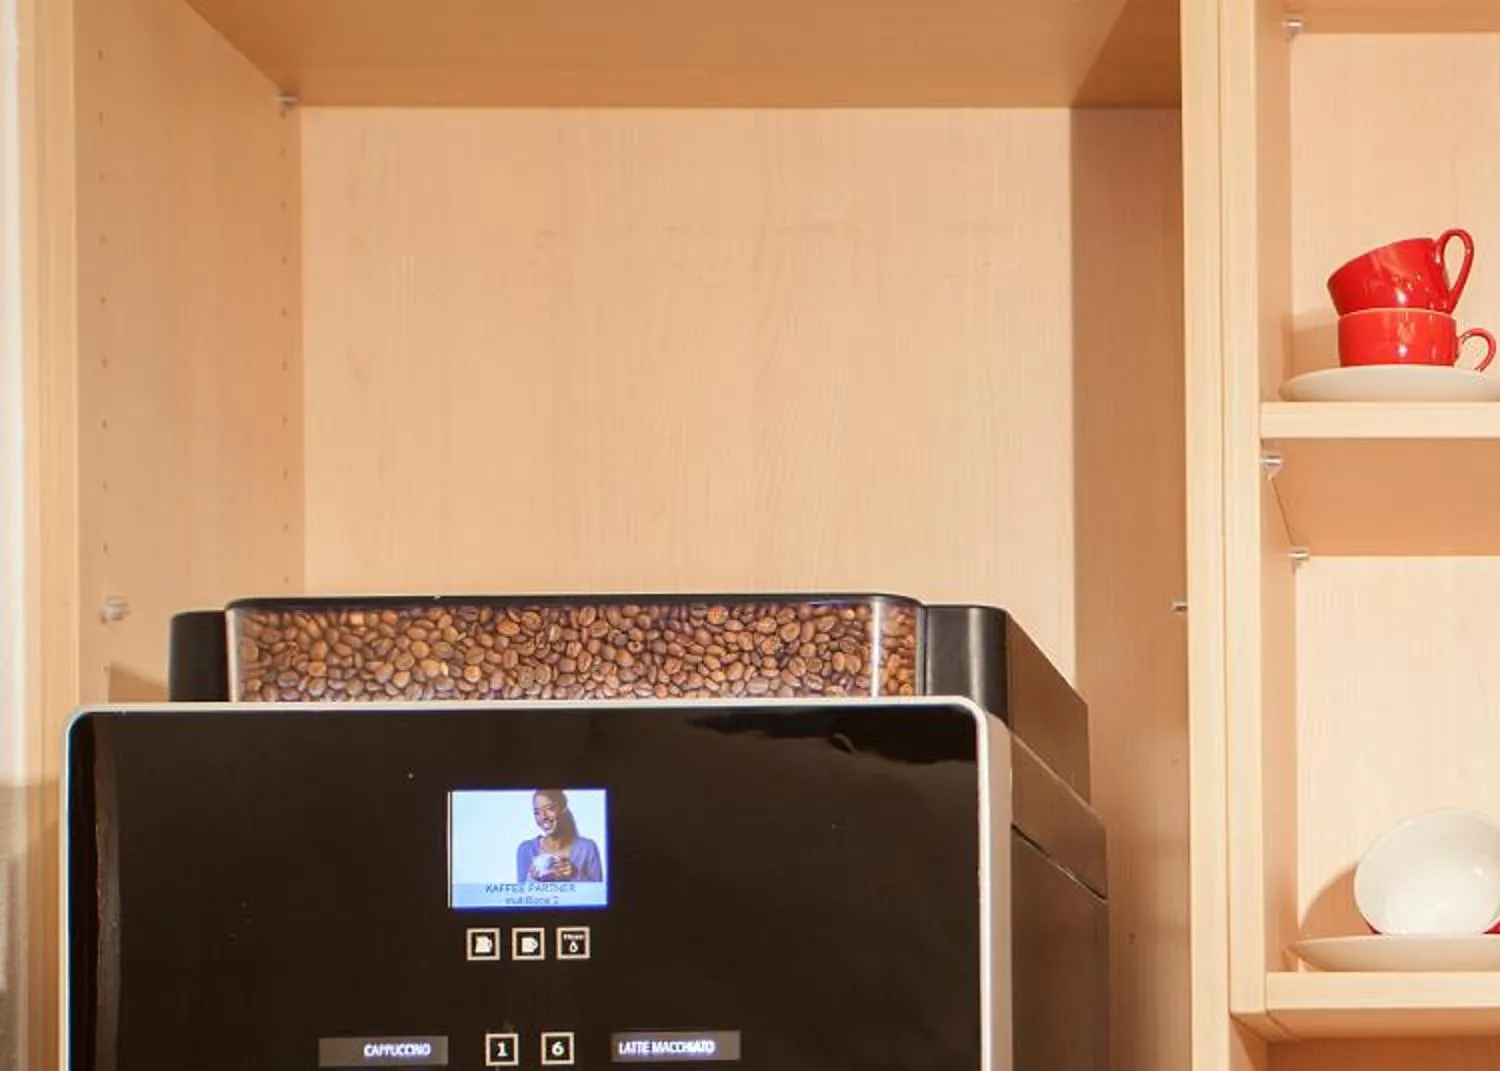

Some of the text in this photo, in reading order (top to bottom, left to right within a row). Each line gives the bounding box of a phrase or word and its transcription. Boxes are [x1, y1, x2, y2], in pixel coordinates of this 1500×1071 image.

[363, 1043, 432, 1057] CAPPUCCINO
[498, 1042, 508, 1057] 1
[551, 1041, 564, 1056] 6
[618, 1040, 716, 1055] LATTE MACCHIATO
